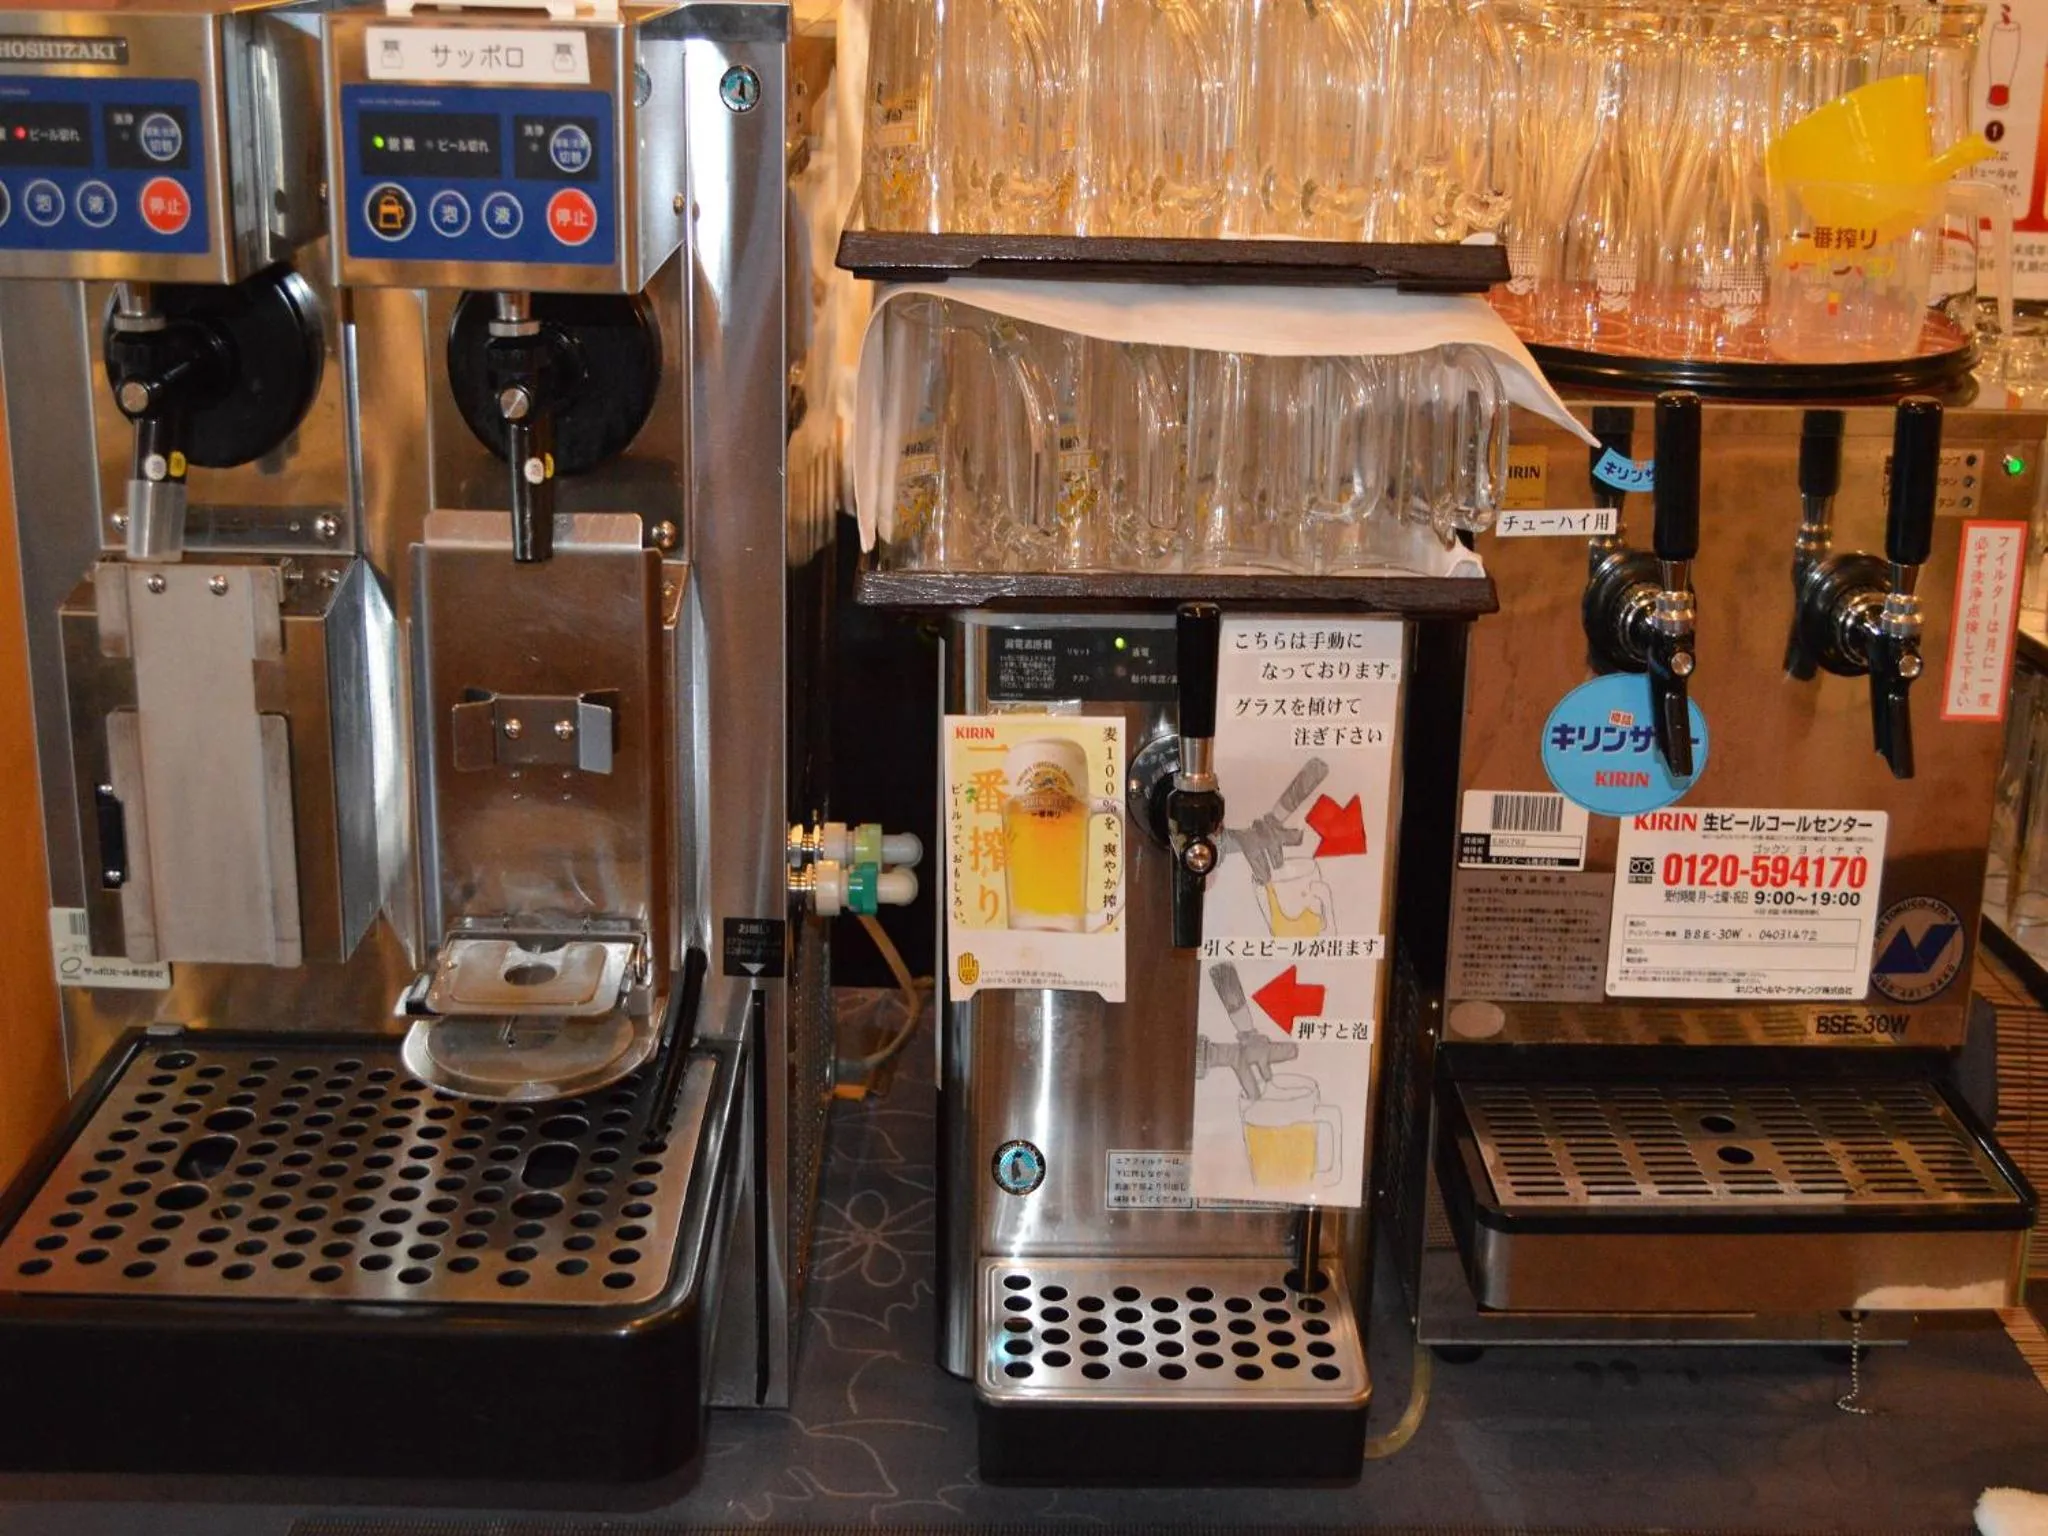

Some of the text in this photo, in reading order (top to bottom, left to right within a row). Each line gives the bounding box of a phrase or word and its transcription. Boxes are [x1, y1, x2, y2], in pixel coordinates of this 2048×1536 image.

[0, 42, 117, 60] HOSHIZAKI
[430, 43, 525, 68] サッポロ
[437, 138, 490, 153] ビール切れ
[150, 198, 182, 216] 停止
[441, 205, 458, 223] 泡
[494, 206, 511, 225] 液
[555, 208, 589, 227] 停止
[1787, 226, 1877, 250] 一番搾り
[1508, 465, 1541, 480] IRIN
[1503, 513, 1609, 532] チューハイ用
[1235, 631, 1363, 650] こちらは手動に
[1261, 661, 1396, 680] なっております。
[1235, 697, 1363, 717] グラスを傾けて
[955, 726, 995, 740] KIRIN
[1294, 726, 1383, 746] 注ぎ下さい
[1551, 723, 1699, 753] キリンサ
[1594, 771, 1650, 787] KIRIN
[1634, 812, 1873, 834] KIRIN 生ビールコールセンター
[967, 743, 1011, 925] 一番搾り
[1662, 852, 1868, 889] 0120-594170
[1204, 938, 1379, 957] 引くとビールが出ます
[1297, 1022, 1368, 1040] 押すと泡
[1816, 1014, 1910, 1035] BSE-30W
